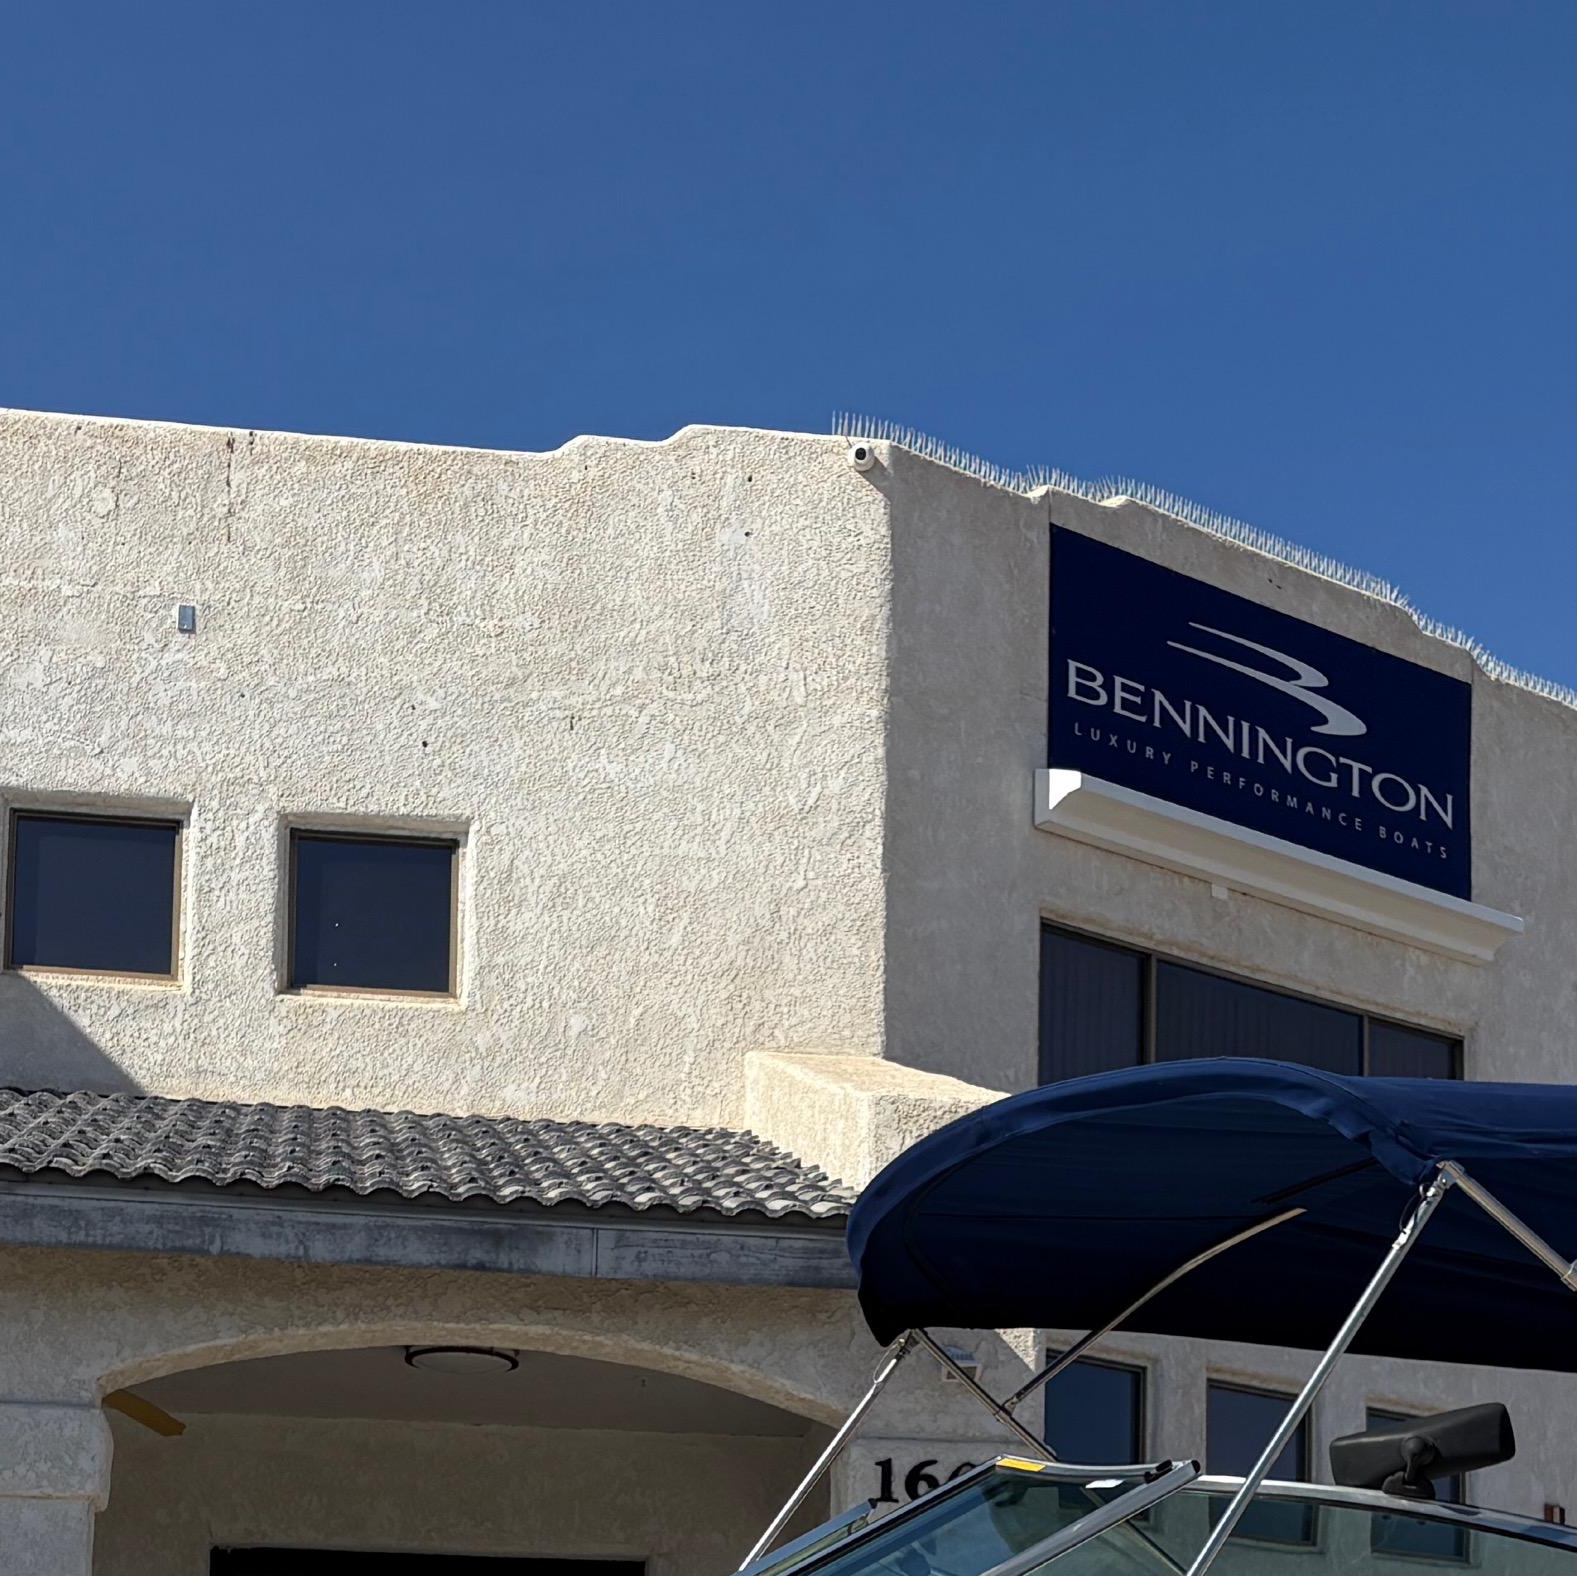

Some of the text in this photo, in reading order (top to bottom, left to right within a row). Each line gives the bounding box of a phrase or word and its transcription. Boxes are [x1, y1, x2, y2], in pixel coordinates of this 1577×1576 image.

[1066, 658, 1454, 831] BENNINGTON
[1073, 722, 1448, 859] LUXURY PERFORMANCE BOATS
